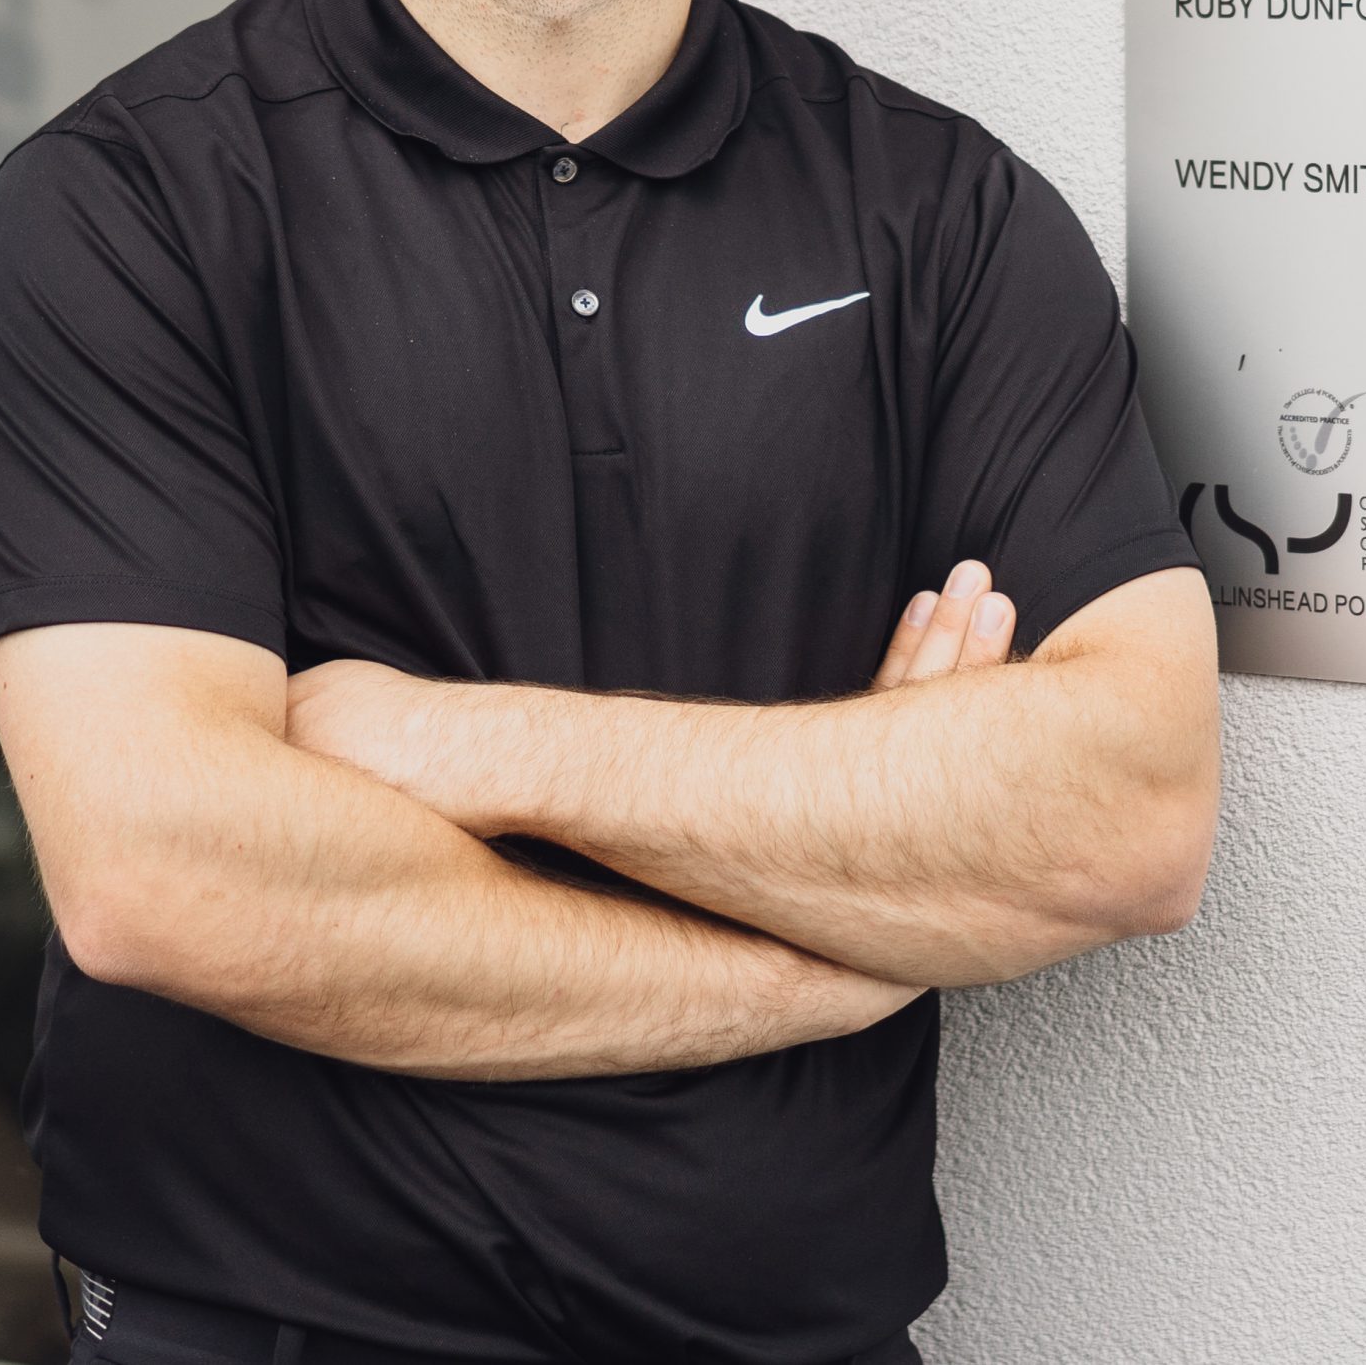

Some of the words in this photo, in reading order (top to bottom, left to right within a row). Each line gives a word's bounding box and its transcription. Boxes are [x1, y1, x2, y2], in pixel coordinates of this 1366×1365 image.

[1174, 158, 1294, 192] WENDY
[1279, 414, 1318, 424] ACCREDITED
[1319, 416, 1350, 426] PRACTICE
